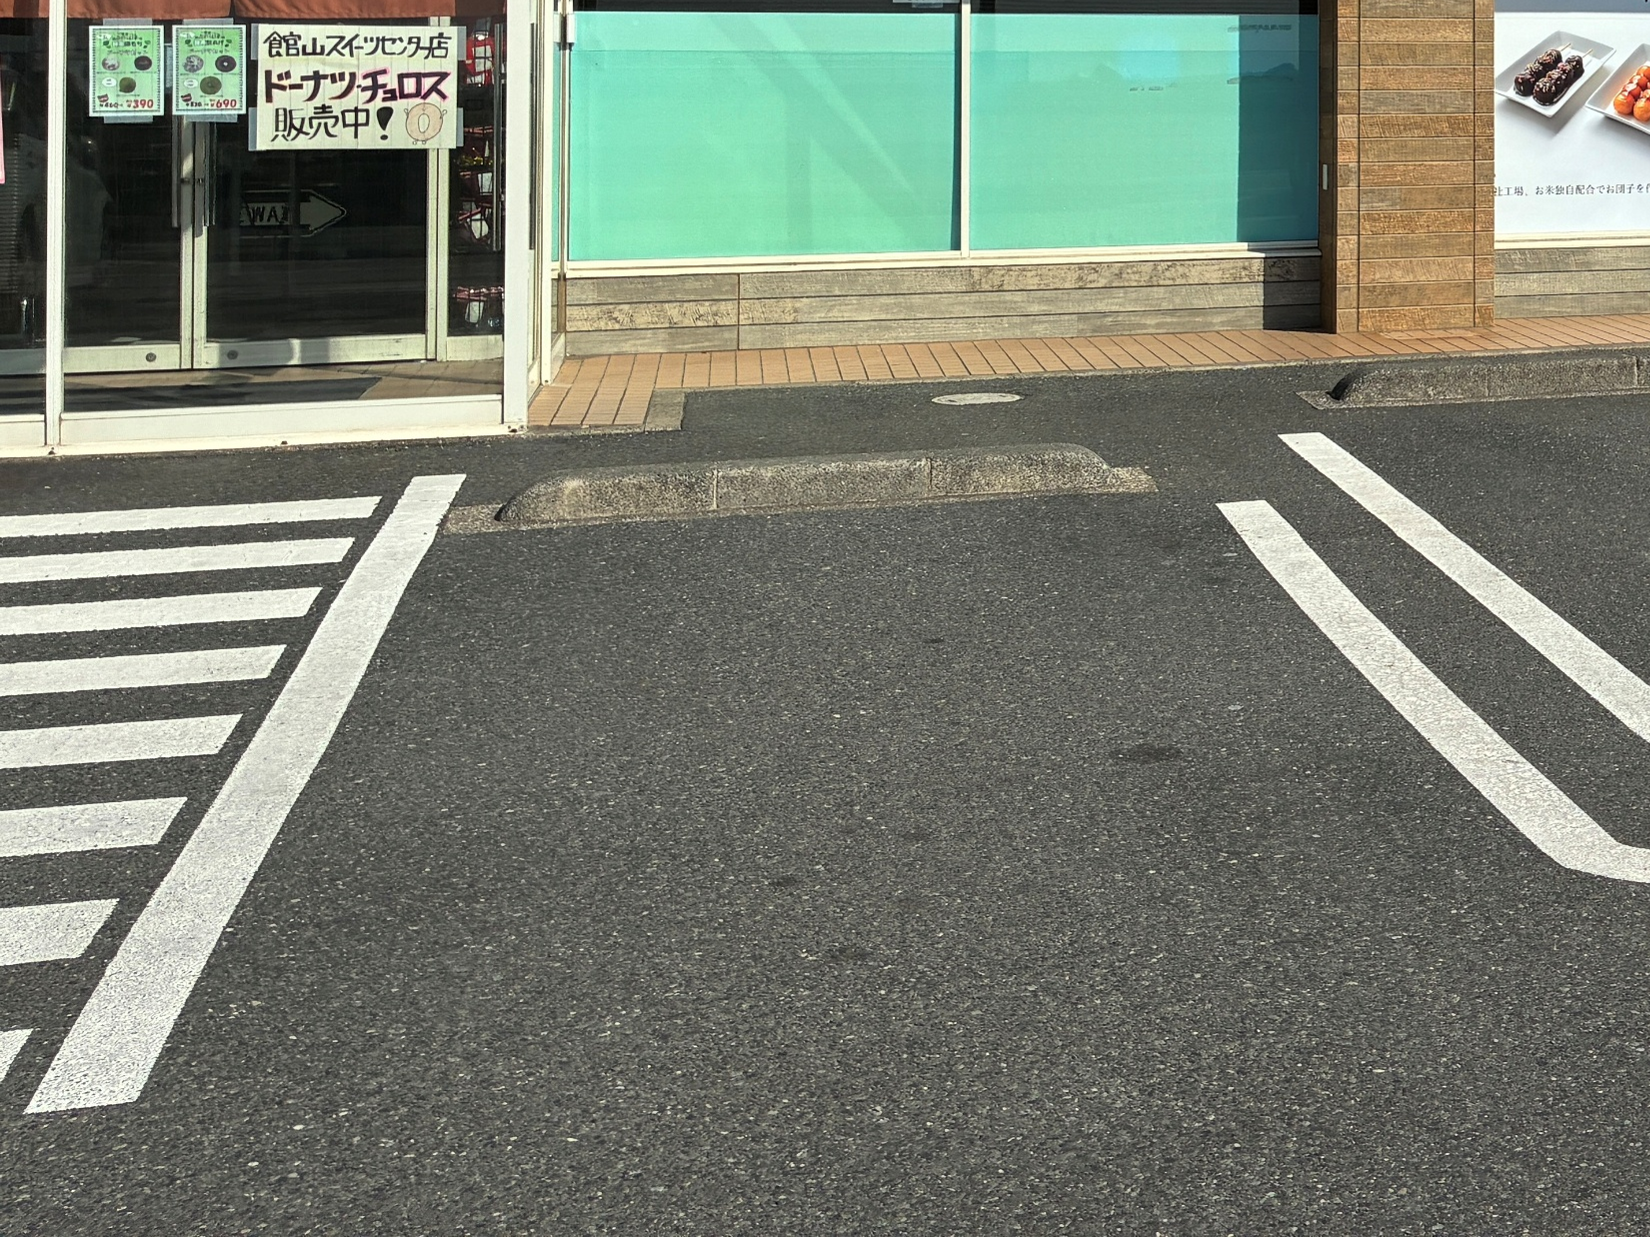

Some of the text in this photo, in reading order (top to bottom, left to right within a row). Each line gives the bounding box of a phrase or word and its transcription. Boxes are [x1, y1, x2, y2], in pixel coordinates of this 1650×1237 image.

[263, 31, 452, 59] 館山スイーツセンター店
